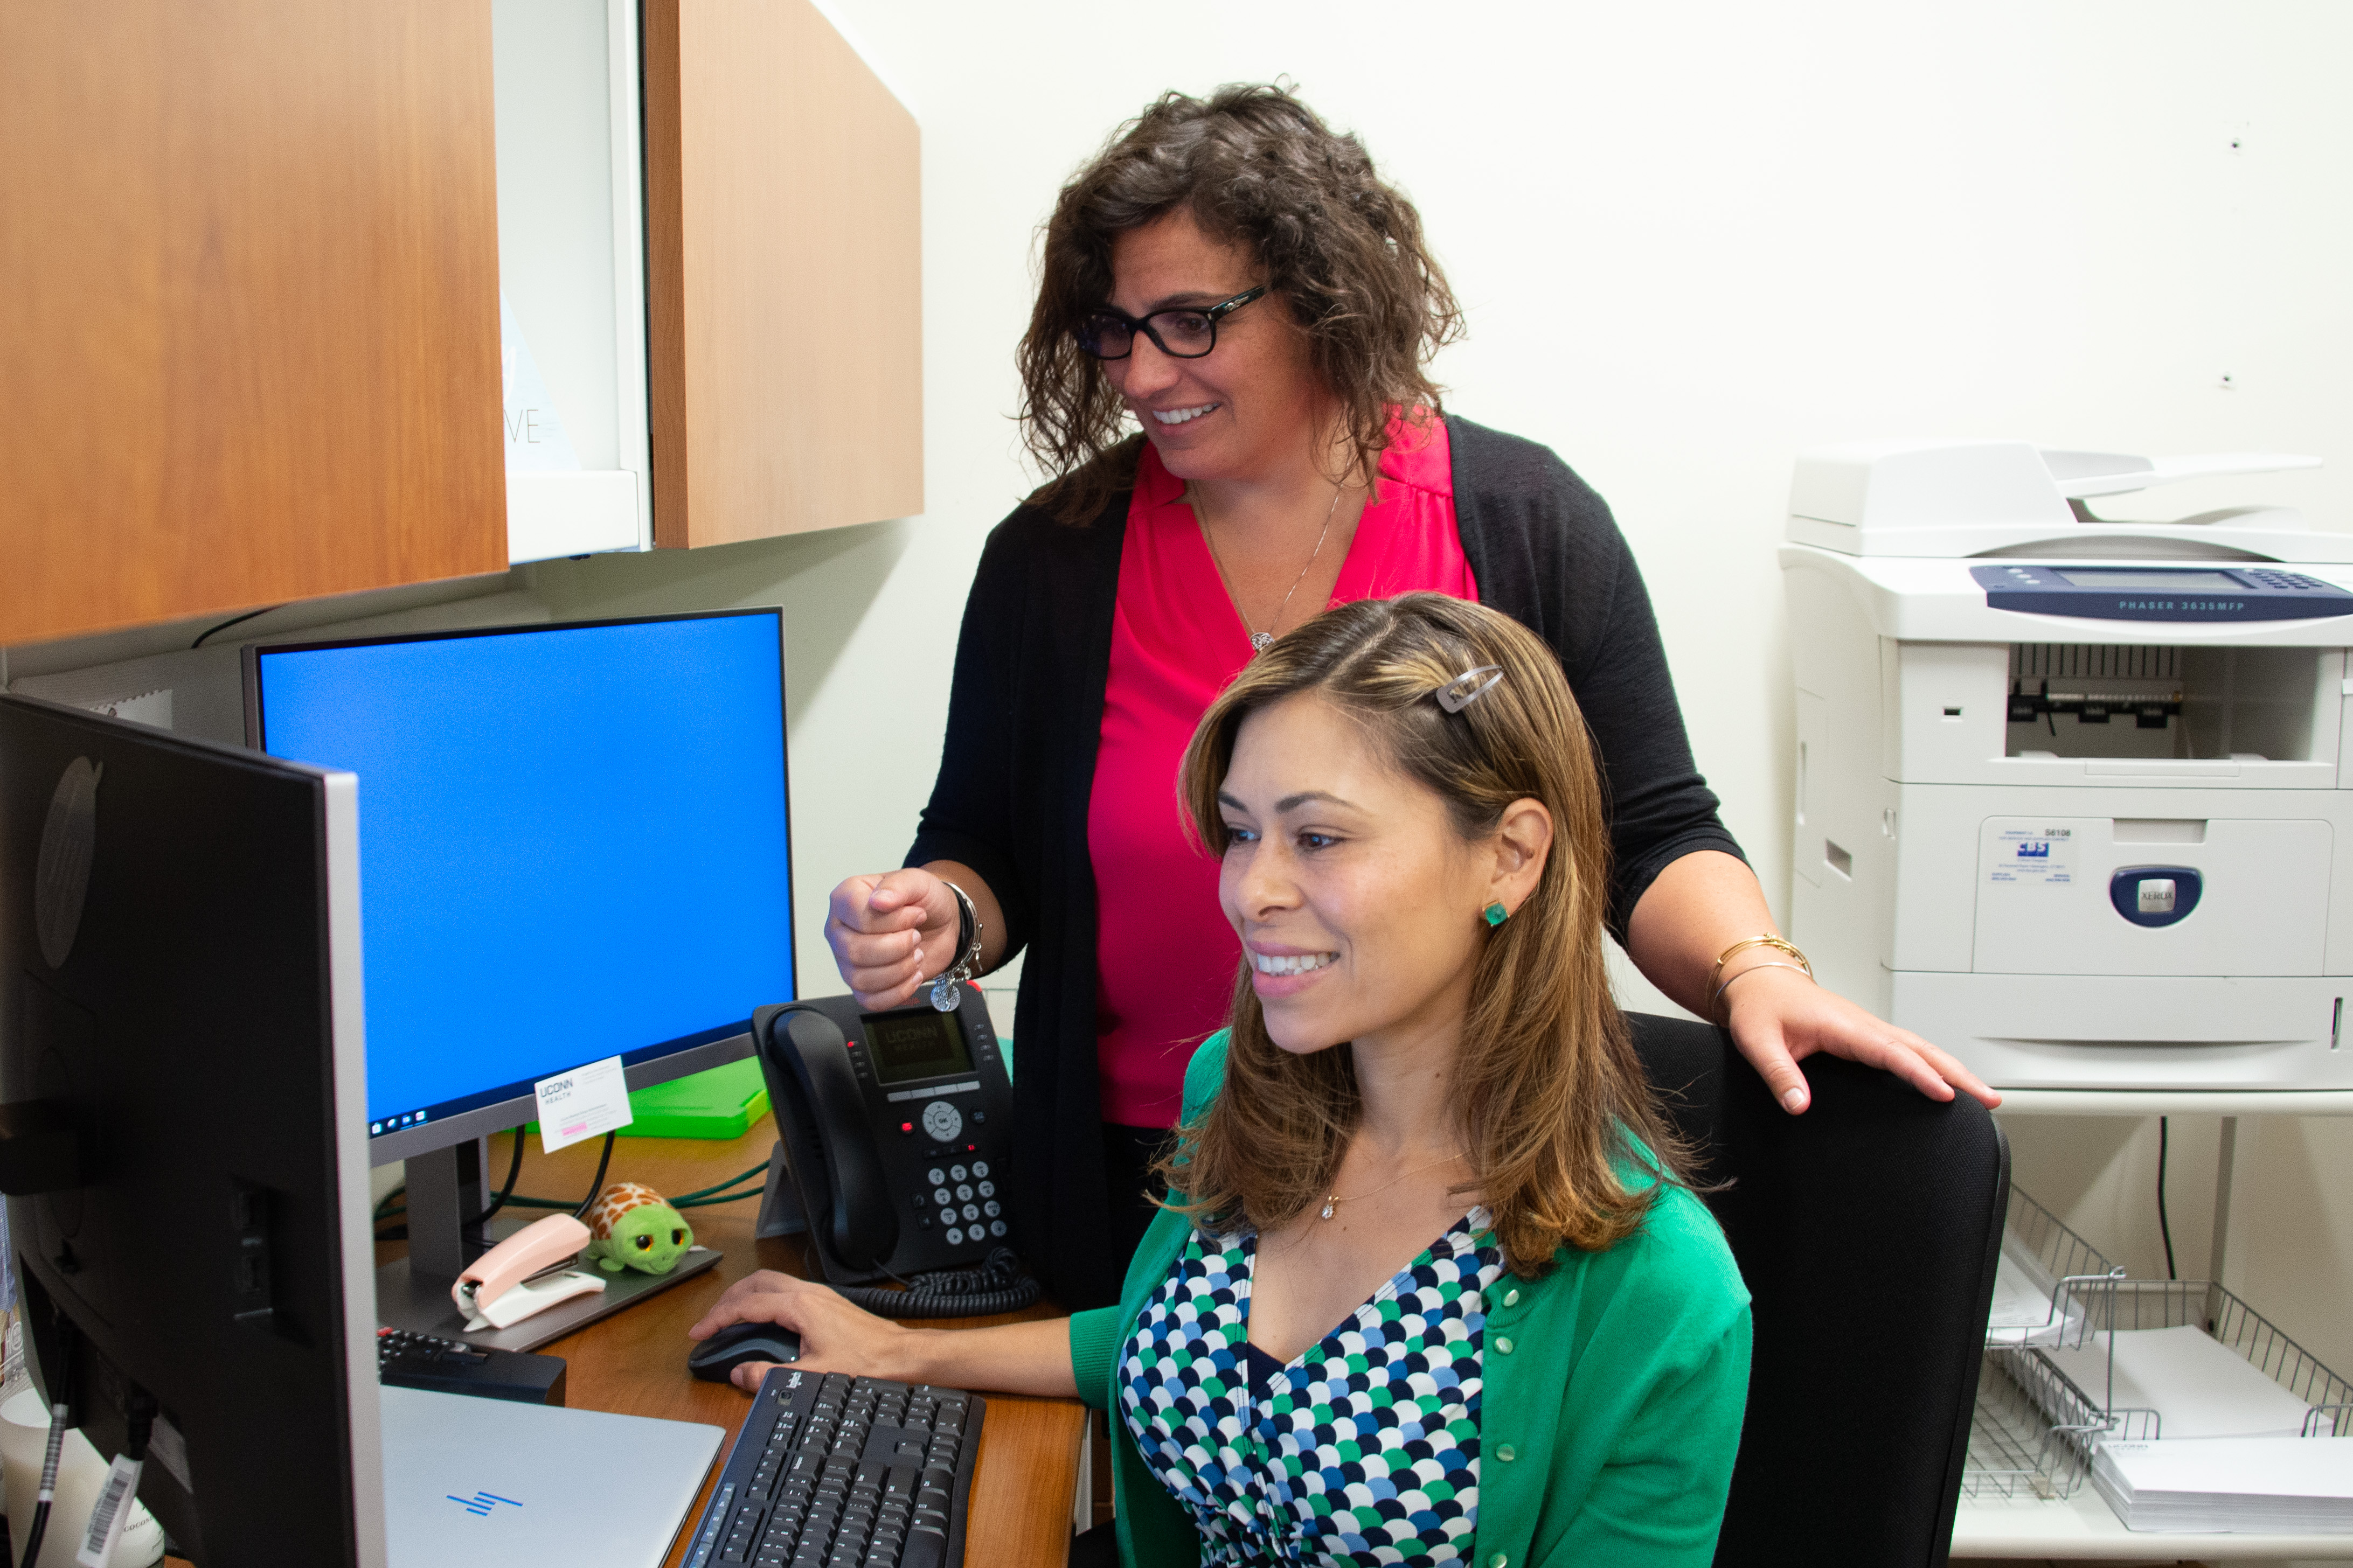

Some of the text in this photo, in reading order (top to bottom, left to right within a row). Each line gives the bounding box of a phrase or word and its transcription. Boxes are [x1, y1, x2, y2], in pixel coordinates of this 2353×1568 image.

[2119, 601, 2174, 609] PHASER
[2142, 891, 2173, 900] XEROX
[540, 1078, 573, 1097] UCONN
[545, 1091, 571, 1104] HEALTH
